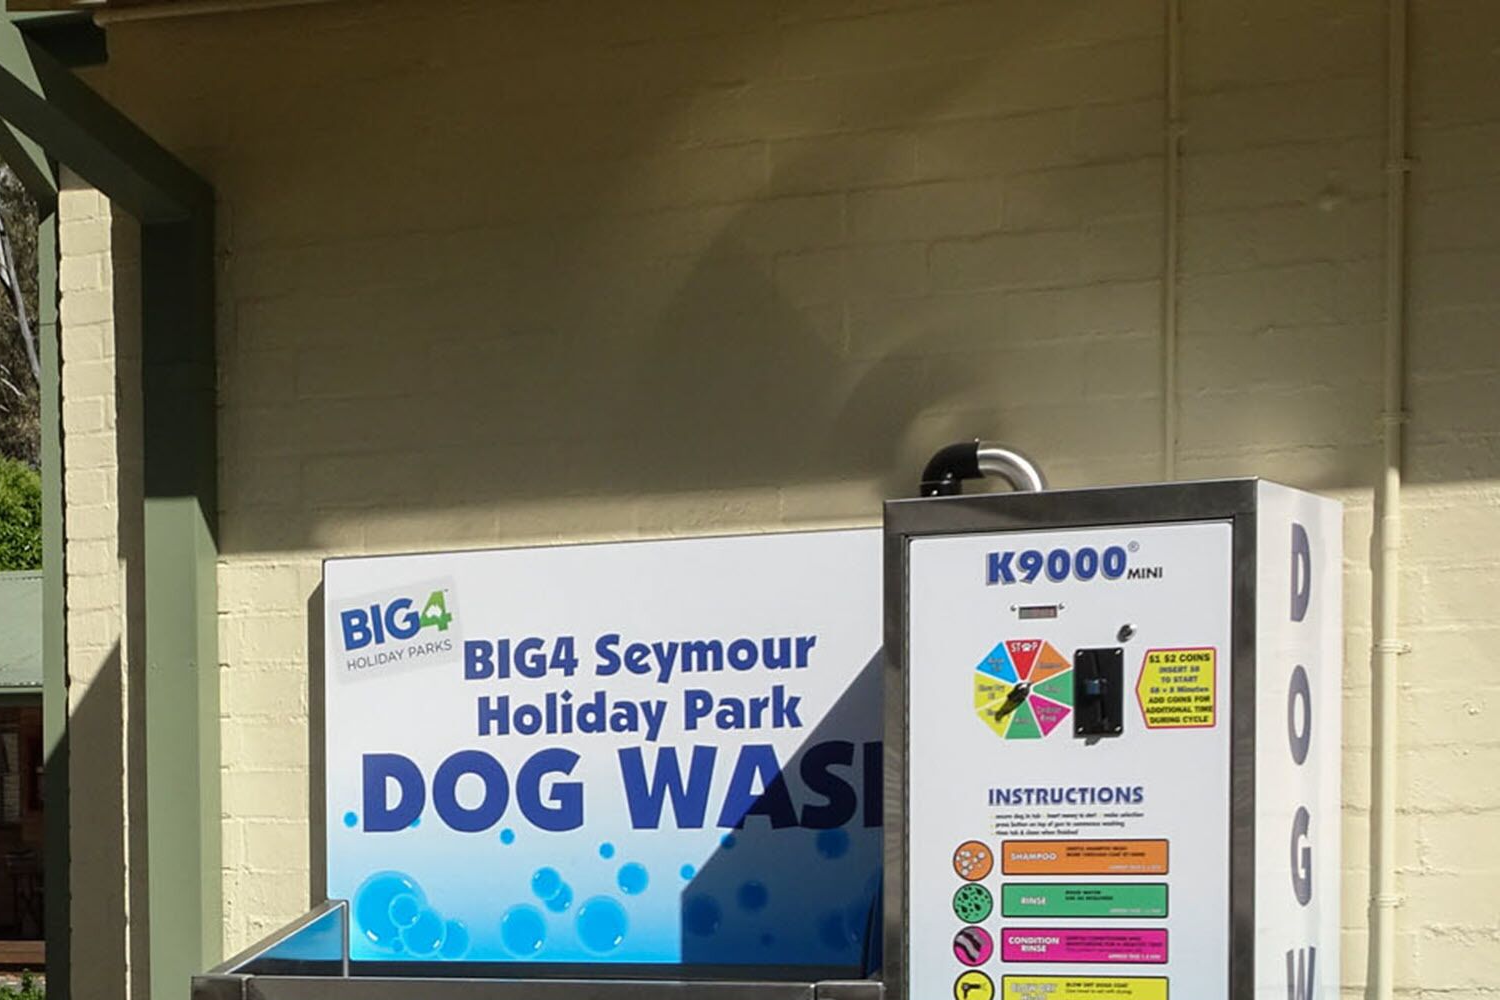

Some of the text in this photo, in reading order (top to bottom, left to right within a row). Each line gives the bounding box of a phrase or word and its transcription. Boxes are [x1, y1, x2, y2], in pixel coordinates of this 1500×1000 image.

[1127, 567, 1163, 580] MINI
[340, 590, 452, 651] BIG4
[346, 639, 452, 671] HOLIDAY PARKS
[463, 633, 817, 683] BIG4 Seymour
[1179, 653, 1210, 662] COINS
[1148, 696, 1165, 704] ADD
[477, 684, 803, 742] Holiday Park
[361, 740, 884, 833] DOG WAS
[988, 786, 1144, 806] INSTRUCTIONS
[1010, 852, 1057, 861] SHAMPOO
[1021, 896, 1046, 905] RINSE
[1008, 936, 1060, 945] CONDITION
[1021, 945, 1046, 953] RINSE
